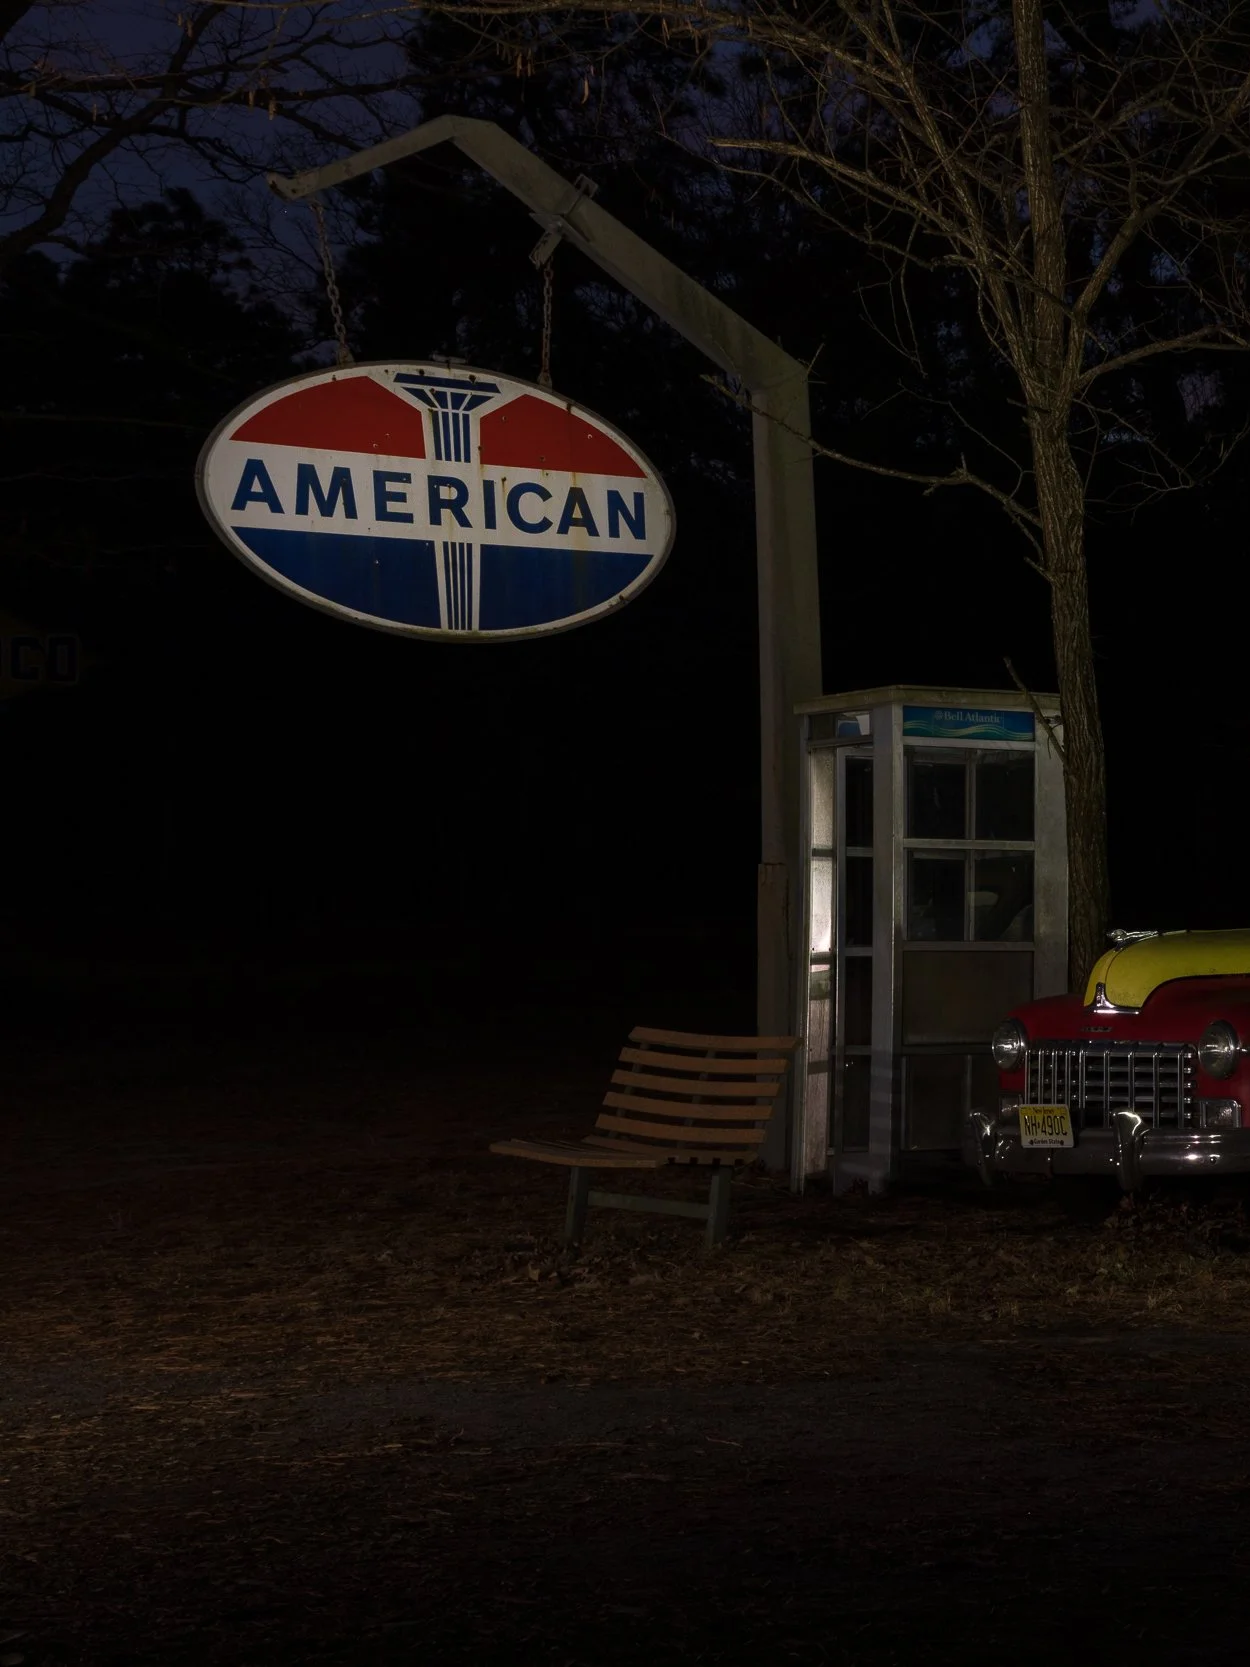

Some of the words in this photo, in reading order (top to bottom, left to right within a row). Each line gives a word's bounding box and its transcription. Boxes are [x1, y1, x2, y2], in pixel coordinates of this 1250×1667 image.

[230, 458, 647, 541] AMERICAN
[0, 634, 80, 685] CO
[944, 711, 963, 721] Bell
[964, 712, 1001, 723] Atlantic
